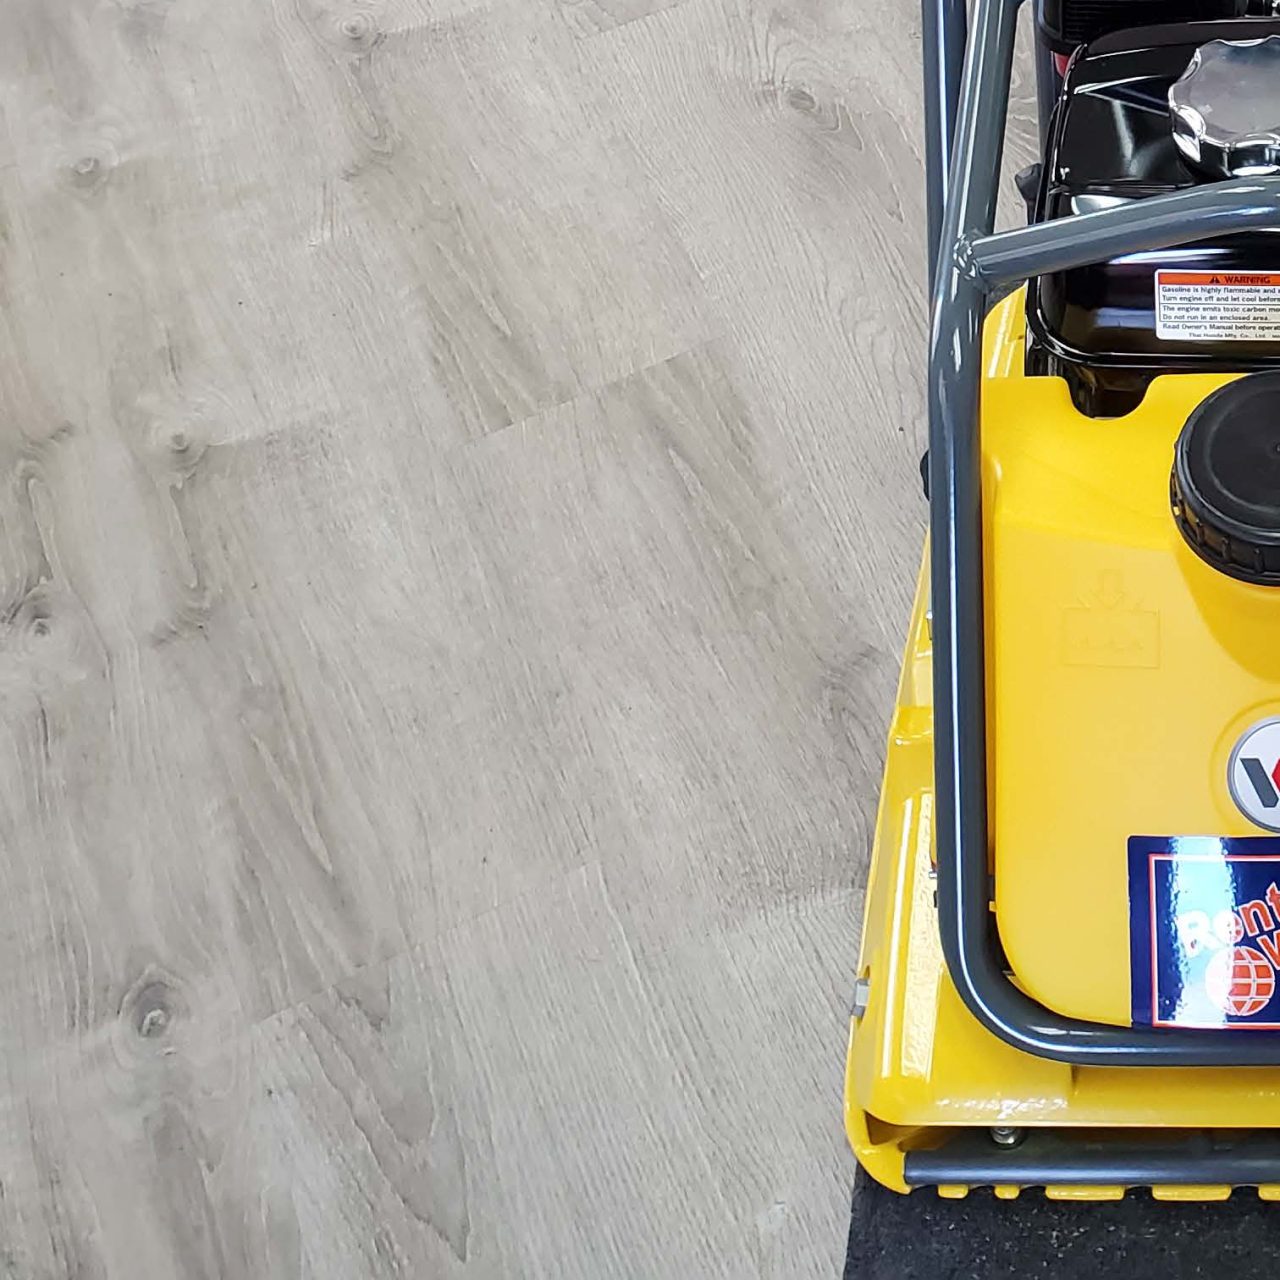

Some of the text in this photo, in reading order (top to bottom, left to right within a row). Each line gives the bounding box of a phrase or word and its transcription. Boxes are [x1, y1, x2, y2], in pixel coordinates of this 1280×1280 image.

[1224, 276, 1271, 284] WARNING
[1179, 295, 1202, 303] engine
[1177, 305, 1200, 313] engine
